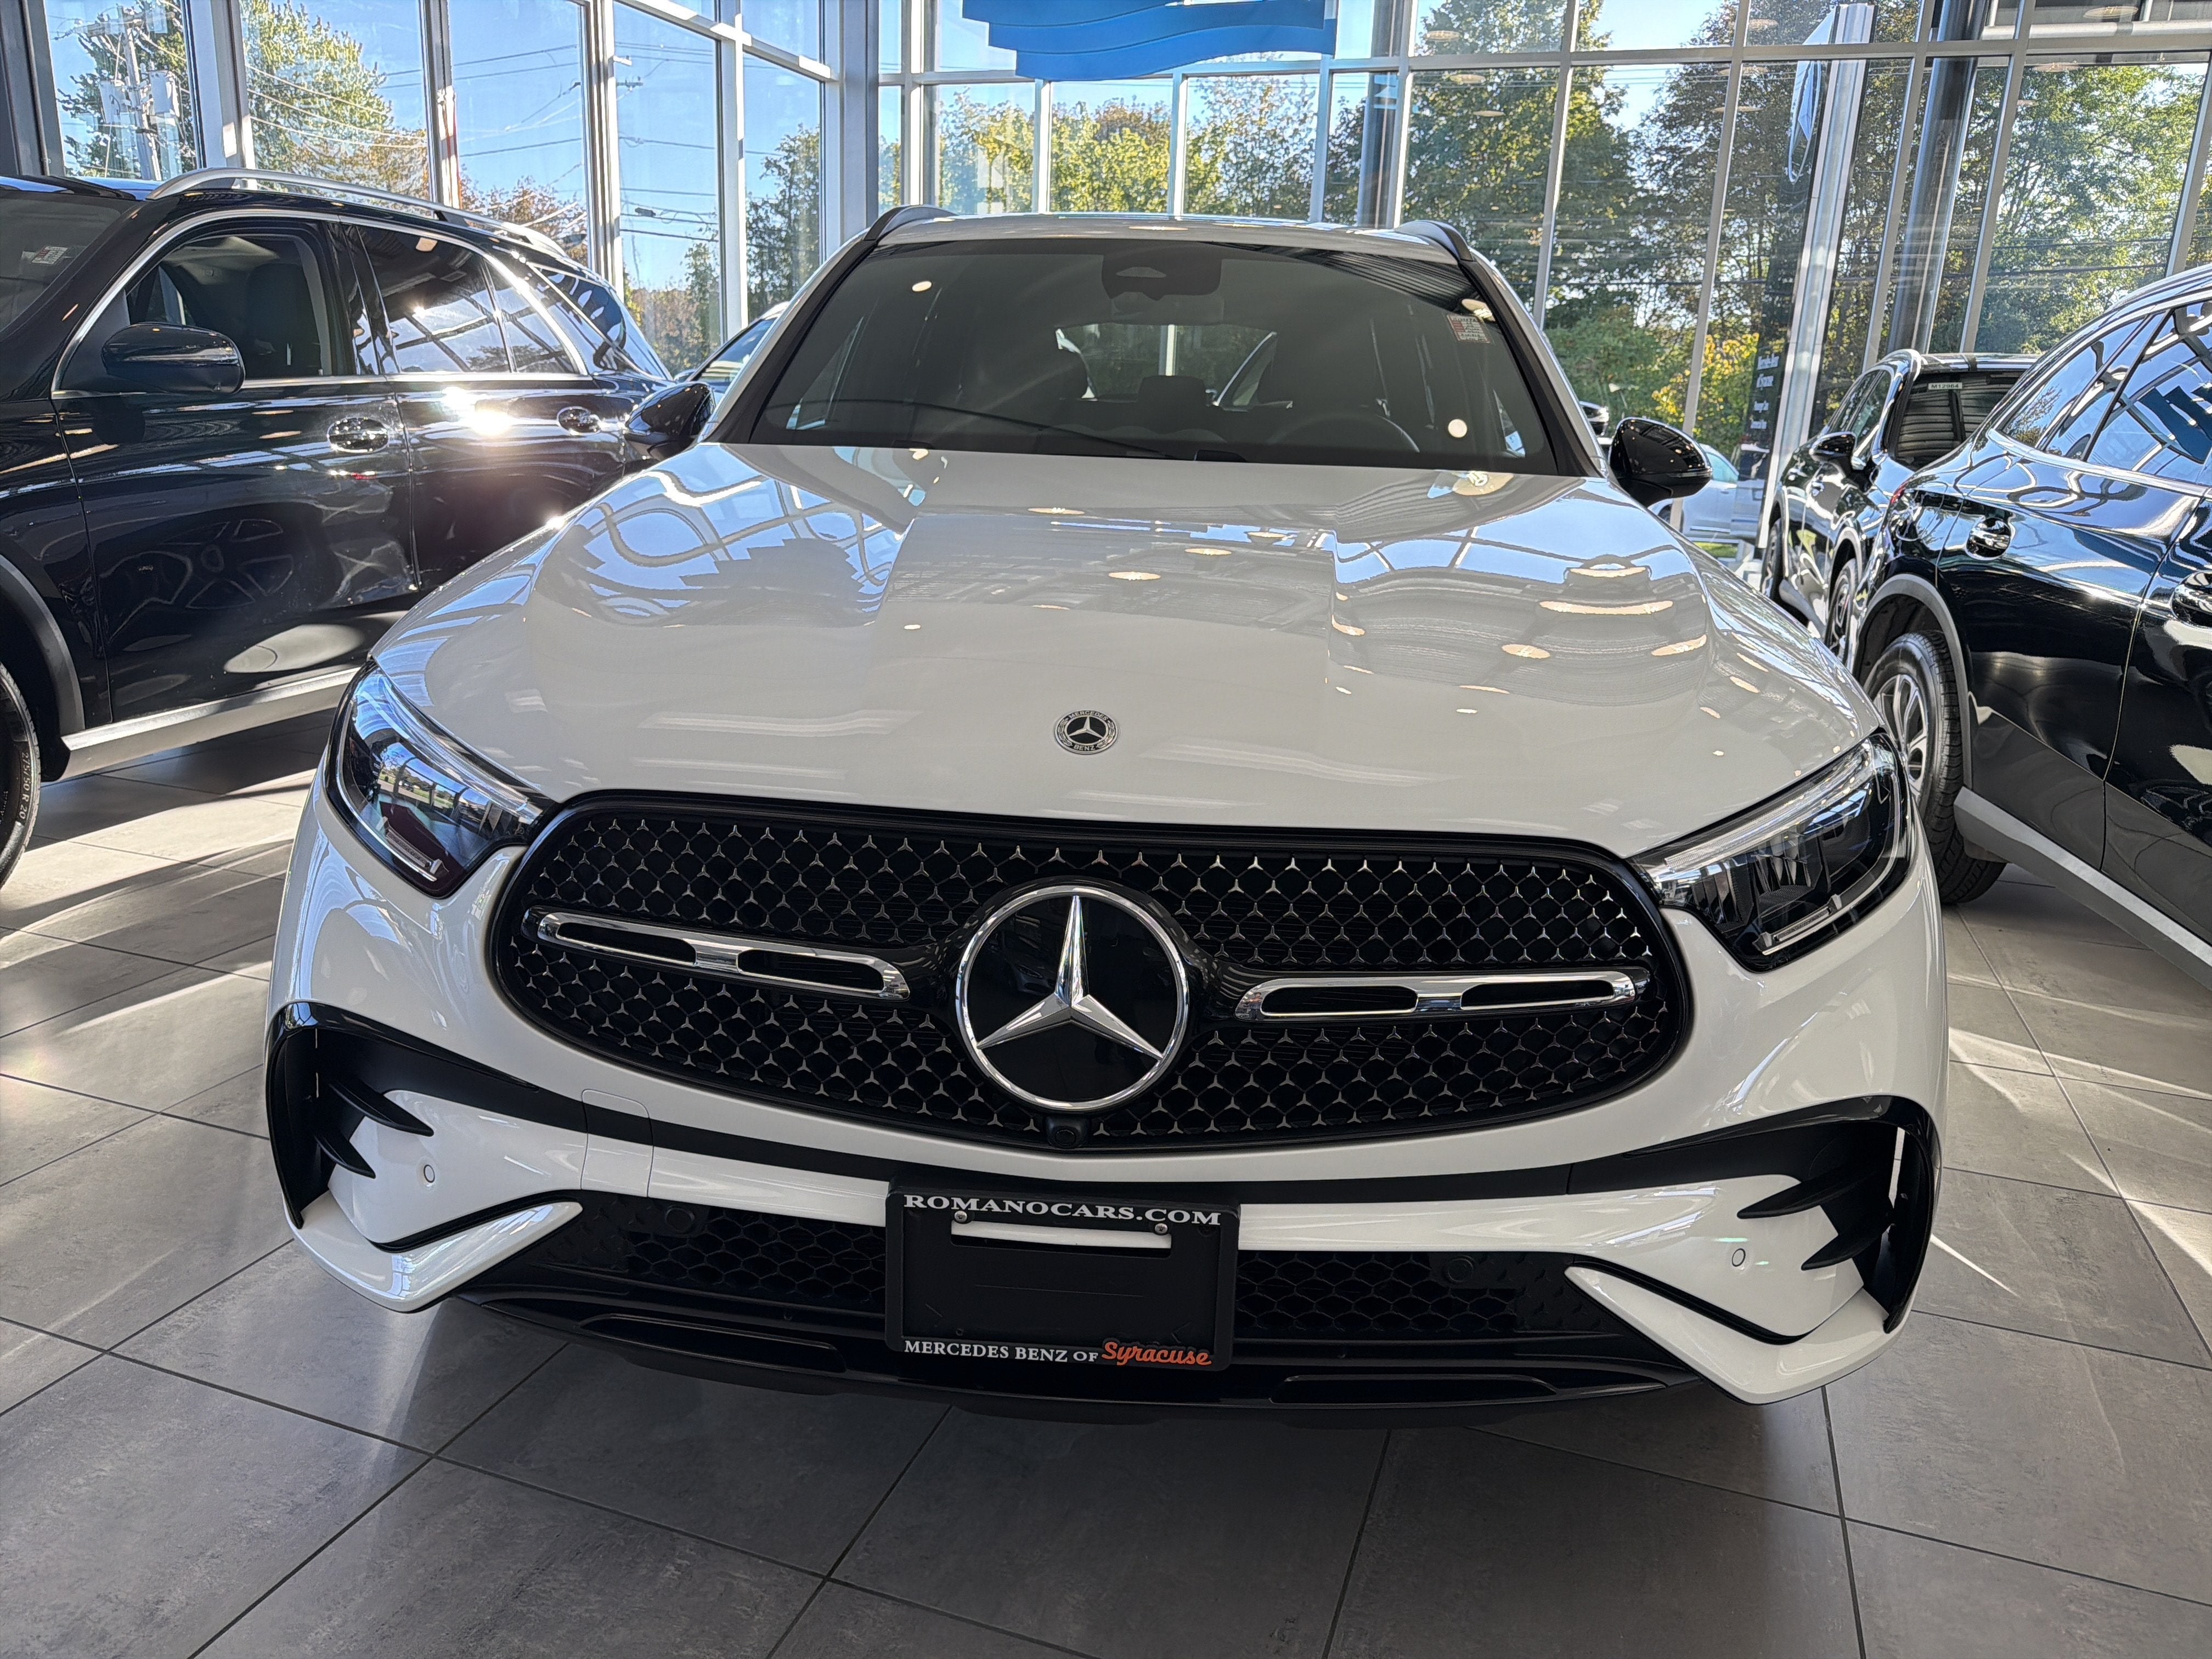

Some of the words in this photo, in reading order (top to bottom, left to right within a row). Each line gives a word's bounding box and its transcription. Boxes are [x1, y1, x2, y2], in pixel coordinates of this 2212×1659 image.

[1069, 711, 1108, 721] MERCEDES
[22, 794, 30, 803] R
[19, 804, 27, 820] 20
[904, 1195, 1220, 1225] ROMANOCARS.COM
[904, 1340, 1009, 1358] MERCEDES
[1014, 1347, 1068, 1362] BENZ
[1073, 1351, 1098, 1362] OF
[1102, 1341, 1212, 1365] Syracuse
